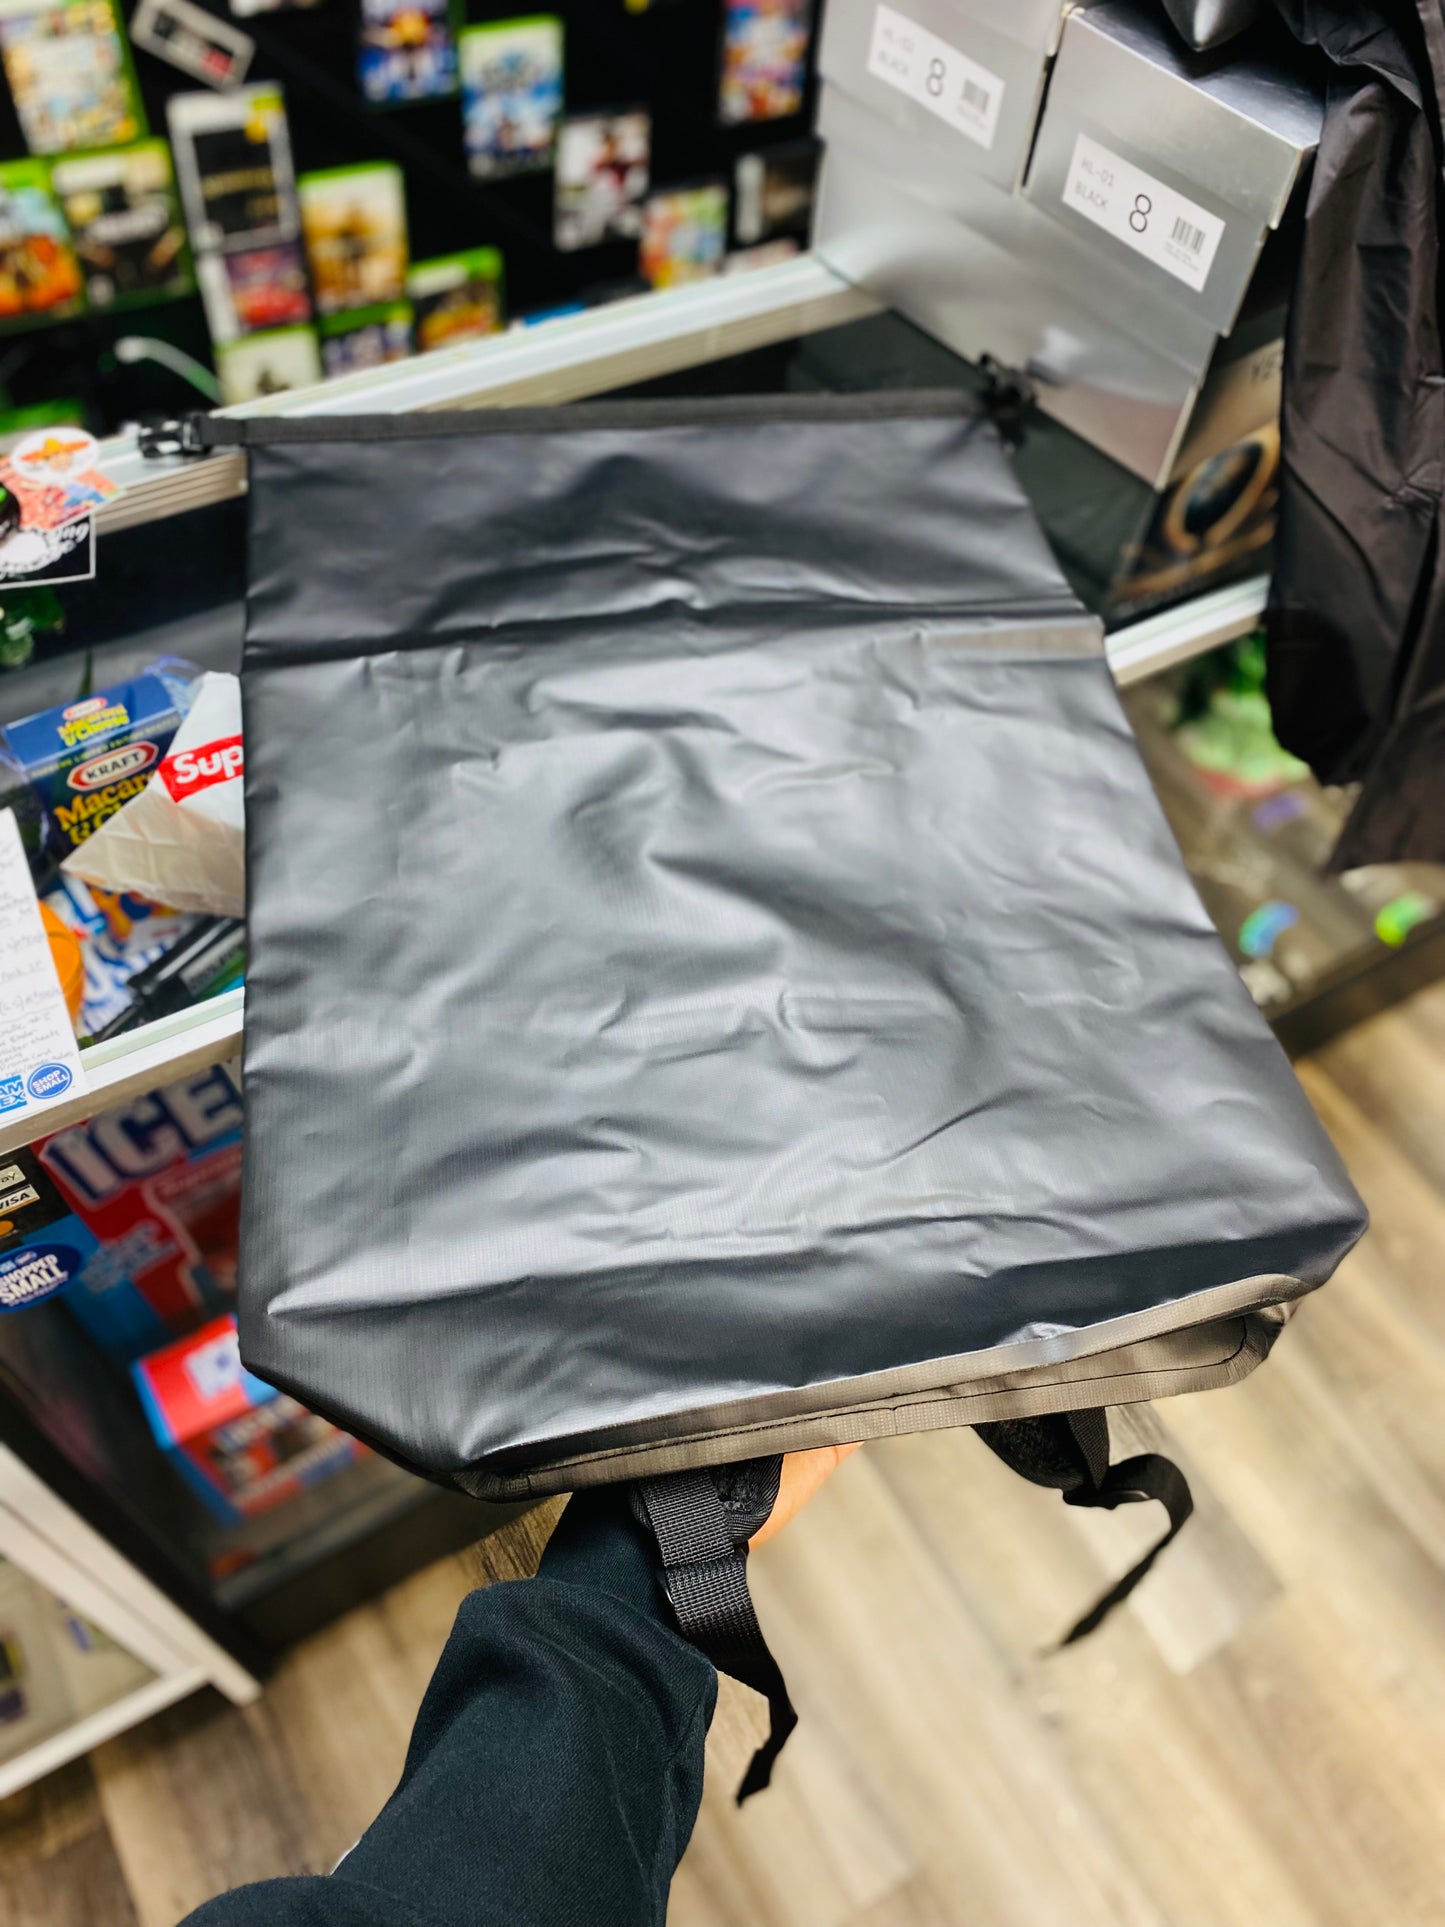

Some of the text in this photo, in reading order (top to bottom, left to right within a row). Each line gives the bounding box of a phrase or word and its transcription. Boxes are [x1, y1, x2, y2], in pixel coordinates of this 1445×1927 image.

[925, 58, 946, 97] 8
[1081, 157, 1115, 187] HL-01
[1075, 181, 1108, 210] BLACK
[1129, 193, 1152, 233] 8
[86, 751, 141, 780] KRAFT
[173, 745, 243, 784] Sup
[33, 1070, 60, 1088] SHOP
[35, 1074, 69, 1094] SMALL
[0, 1267, 68, 1304] SMALL
